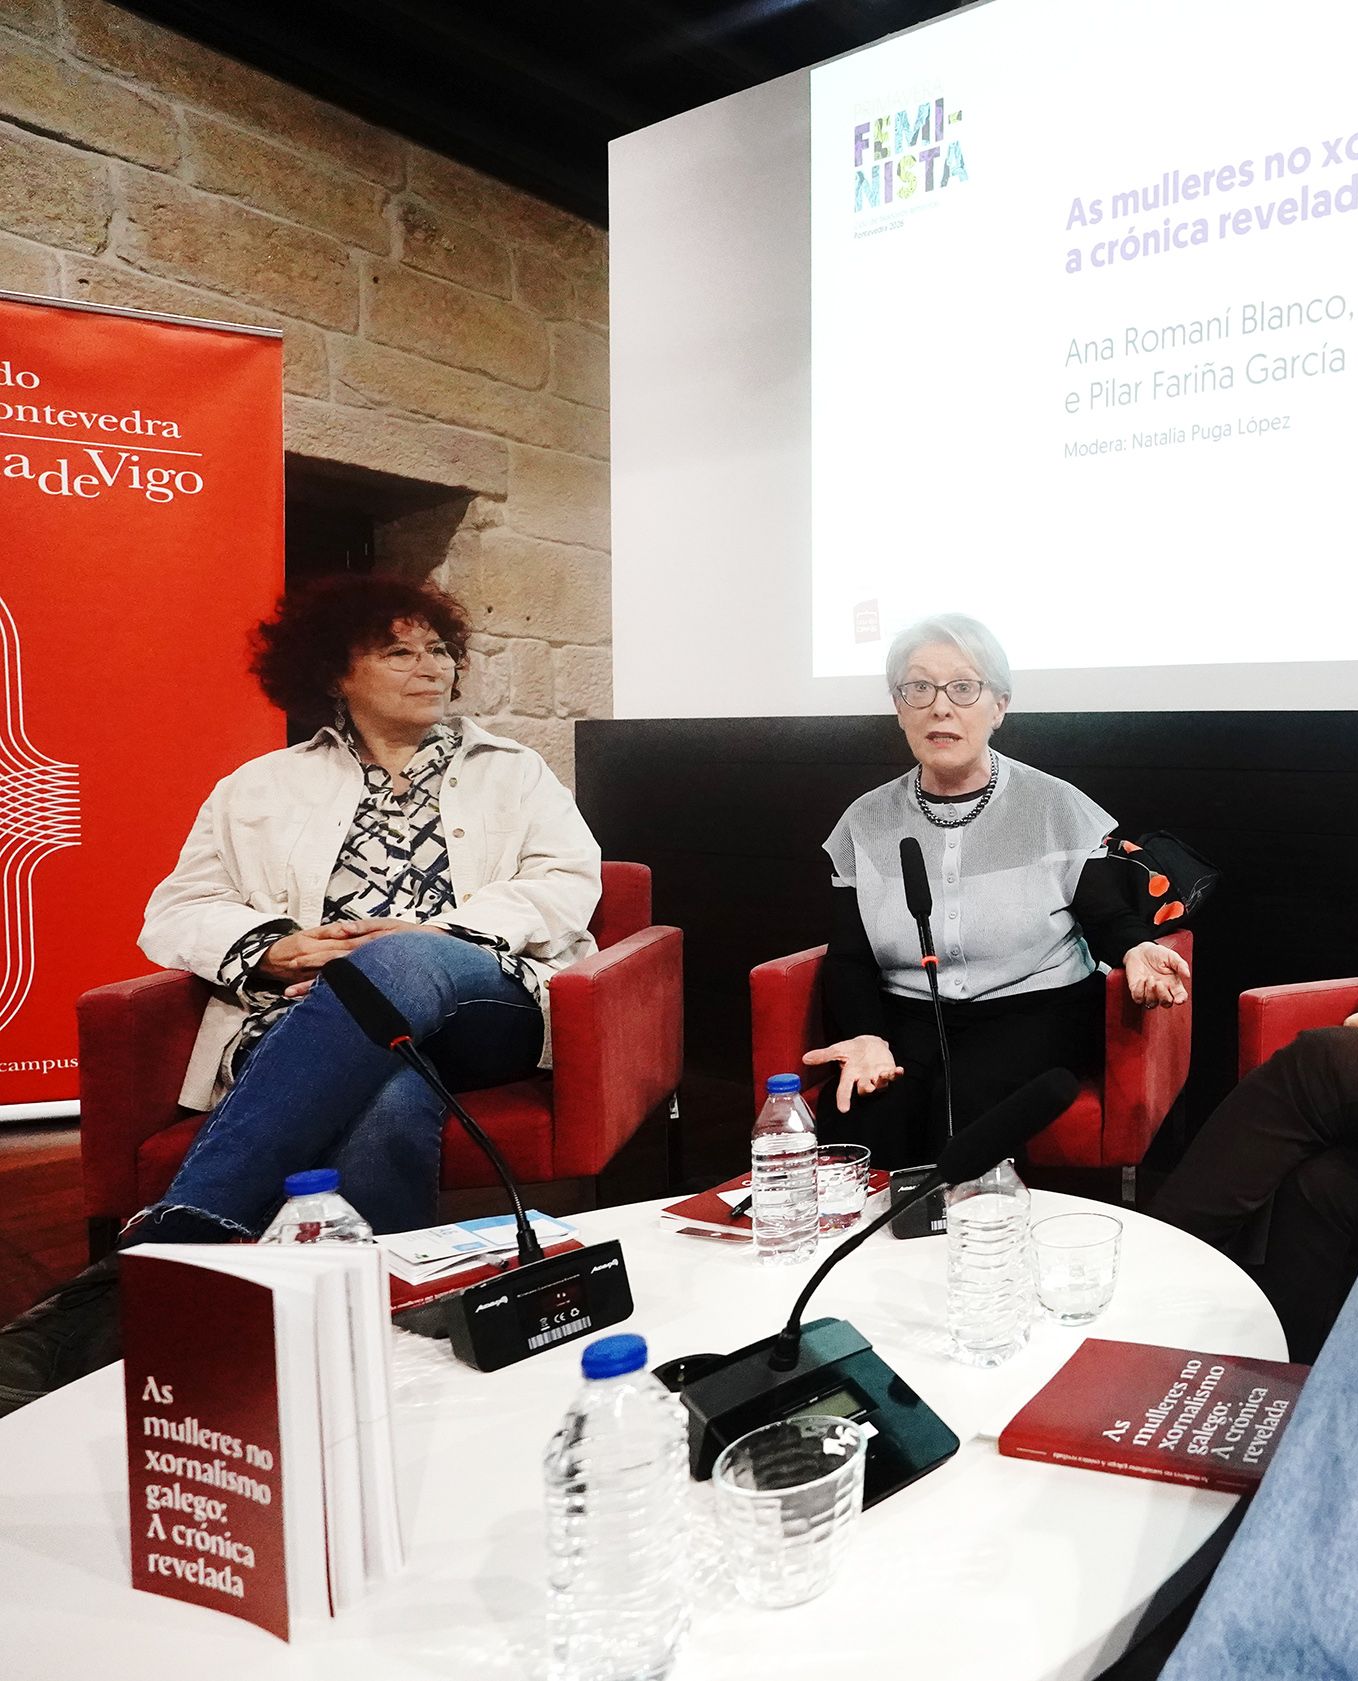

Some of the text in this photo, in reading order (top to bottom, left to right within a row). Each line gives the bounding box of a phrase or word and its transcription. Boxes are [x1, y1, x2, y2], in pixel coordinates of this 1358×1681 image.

[854, 140, 969, 213] NISTA
[1065, 197, 1104, 230] As
[1111, 159, 1254, 219] mulleres
[1264, 145, 1311, 181] no
[1065, 248, 1082, 273] a
[1090, 218, 1209, 268] crónica
[1064, 337, 1114, 368] Ana
[1125, 307, 1231, 356] Romaní
[1241, 294, 1354, 335] Blanco,
[1065, 341, 1346, 414] e Pilar Fariña García
[1064, 413, 1291, 459] Modera: Natalia Puga López
[0, 1058, 79, 1075] campus
[142, 1376, 174, 1404] As
[1132, 1359, 1202, 1446] mulleres no
[1158, 1365, 1225, 1450] xornalismo
[143, 1416, 274, 1470] mulleres no
[1102, 1420, 1131, 1442] As
[1187, 1401, 1232, 1456] galego:
[1210, 1387, 1268, 1460] A crónica
[1242, 1399, 1290, 1464] revelada
[145, 1450, 271, 1505] xornalismo
[145, 1482, 228, 1523] galego:
[147, 1513, 255, 1568] A crónica
[148, 1553, 244, 1599] revelada
